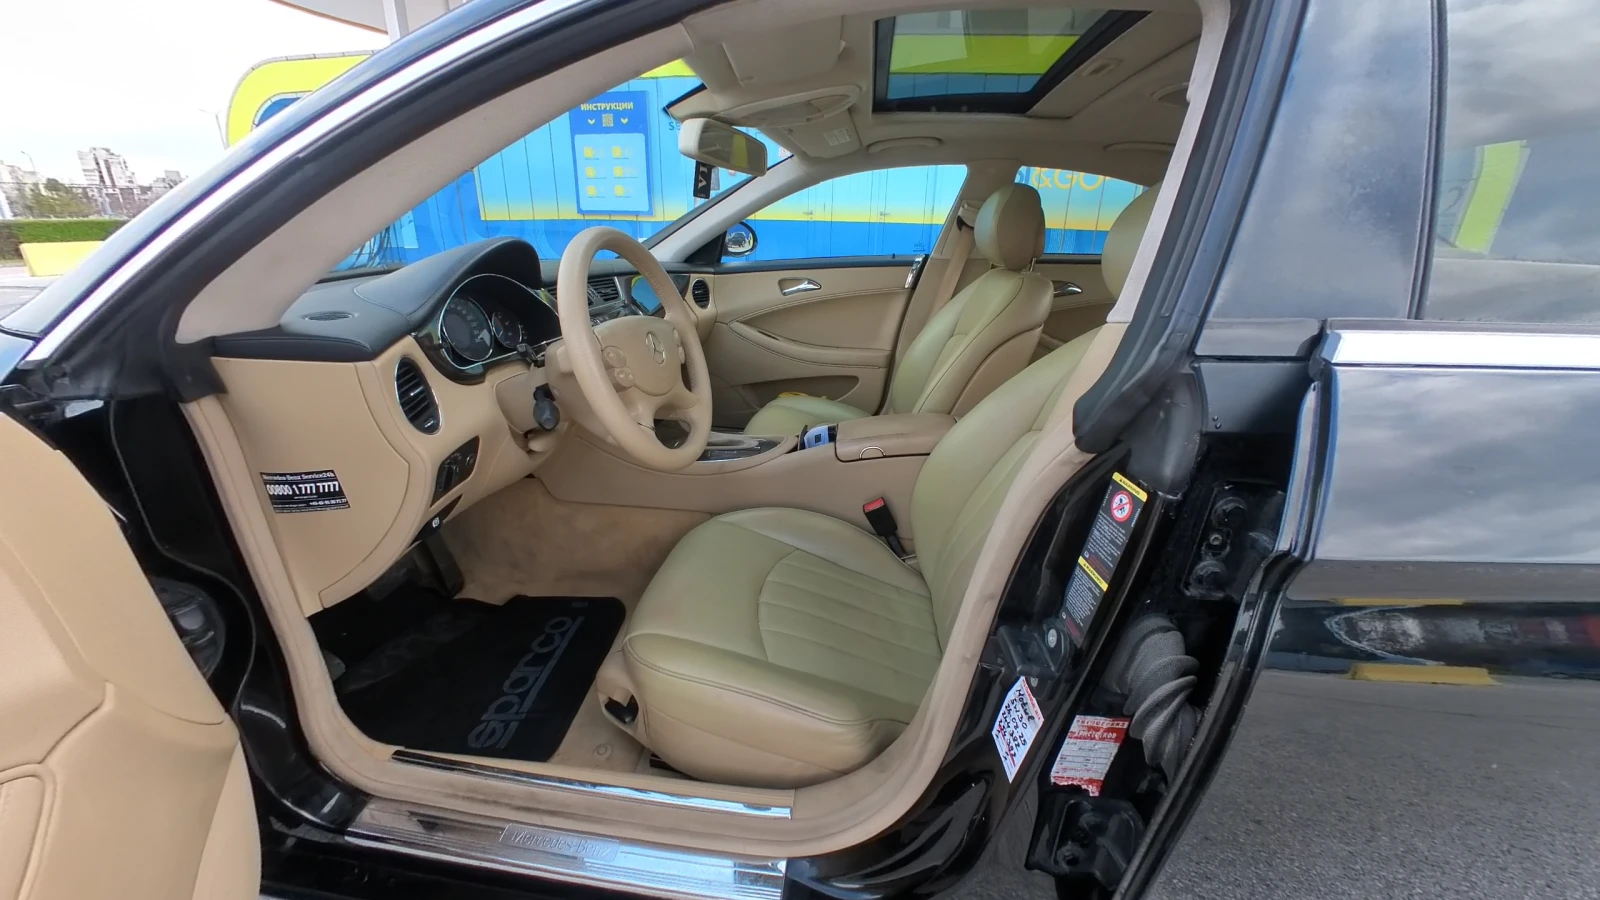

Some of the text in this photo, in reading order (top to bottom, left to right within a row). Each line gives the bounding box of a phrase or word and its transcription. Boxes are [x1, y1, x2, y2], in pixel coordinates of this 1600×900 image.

[580, 102, 633, 111] ИНСТРУКЦИИ
[266, 484, 292, 495] 00800
[316, 481, 339, 492] 7777
[468, 616, 580, 748] sparco
[511, 830, 609, 857] Mercedes-Benz
